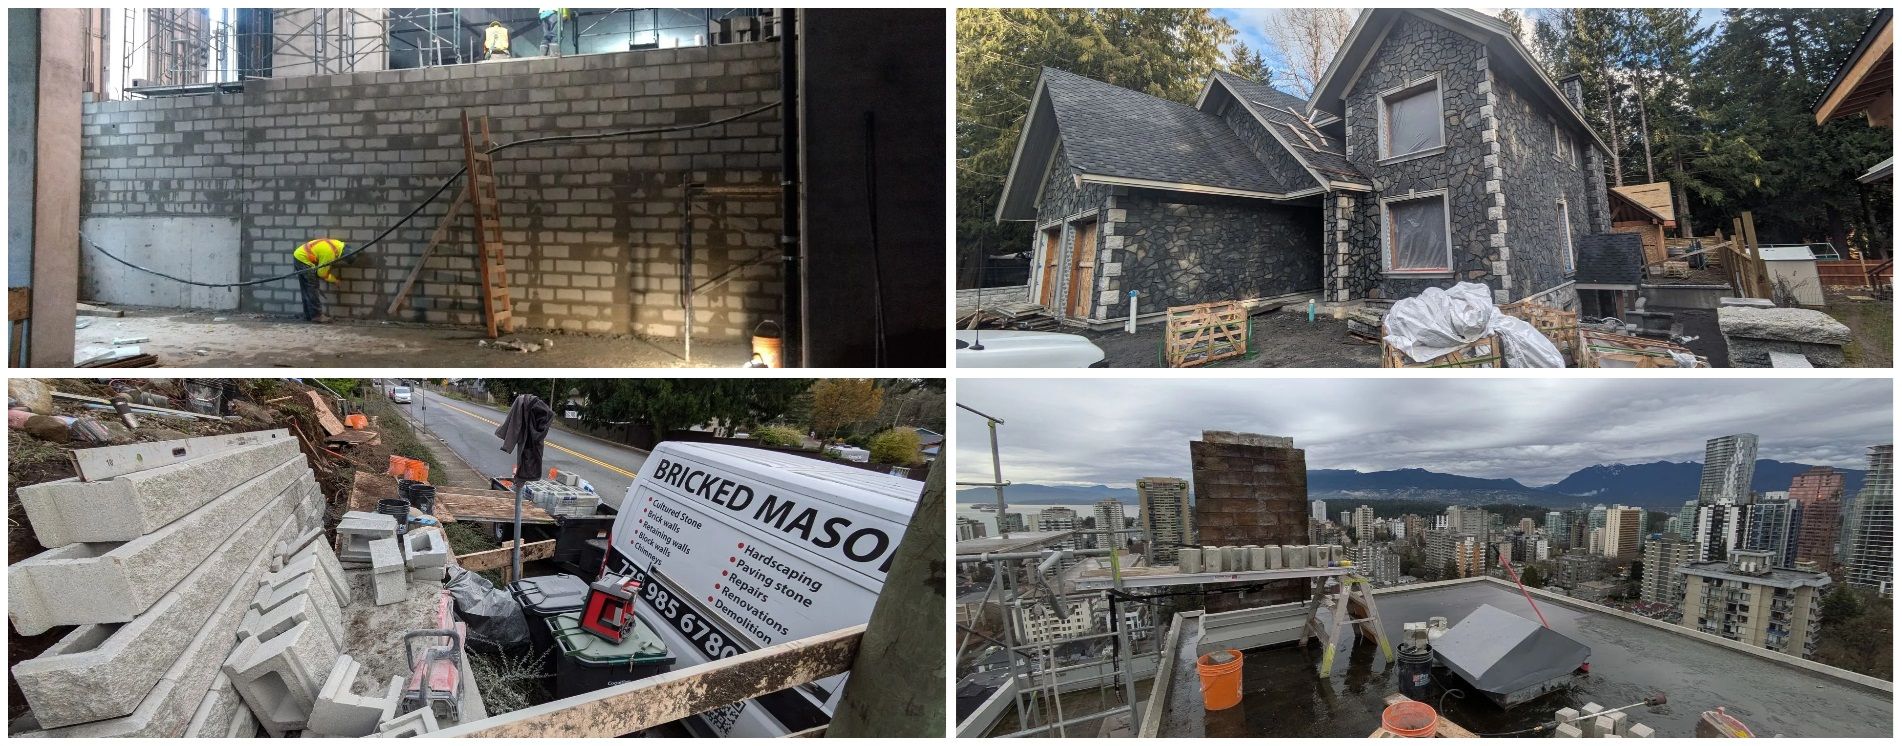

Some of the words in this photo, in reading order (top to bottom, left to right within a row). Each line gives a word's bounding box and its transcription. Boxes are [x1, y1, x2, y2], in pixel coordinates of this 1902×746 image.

[647, 509, 662, 524] Brick
[663, 521, 681, 534] walls
[652, 499, 681, 518] Cultured
[680, 513, 702, 530] Stone
[653, 458, 755, 511] BRICKED
[753, 494, 900, 573] MASO
[634, 542, 662, 566] Chimneys
[638, 531, 654, 546] Block
[654, 543, 671, 558] walls
[642, 520, 672, 544] Retaining
[672, 540, 691, 555] walls
[736, 559, 774, 588] Paving
[774, 582, 813, 608] stone
[744, 544, 823, 593] Hardscaping
[645, 582, 680, 619] 985
[728, 572, 769, 603] Repairs
[714, 598, 773, 645] Demolition
[721, 586, 789, 636] Renovations
